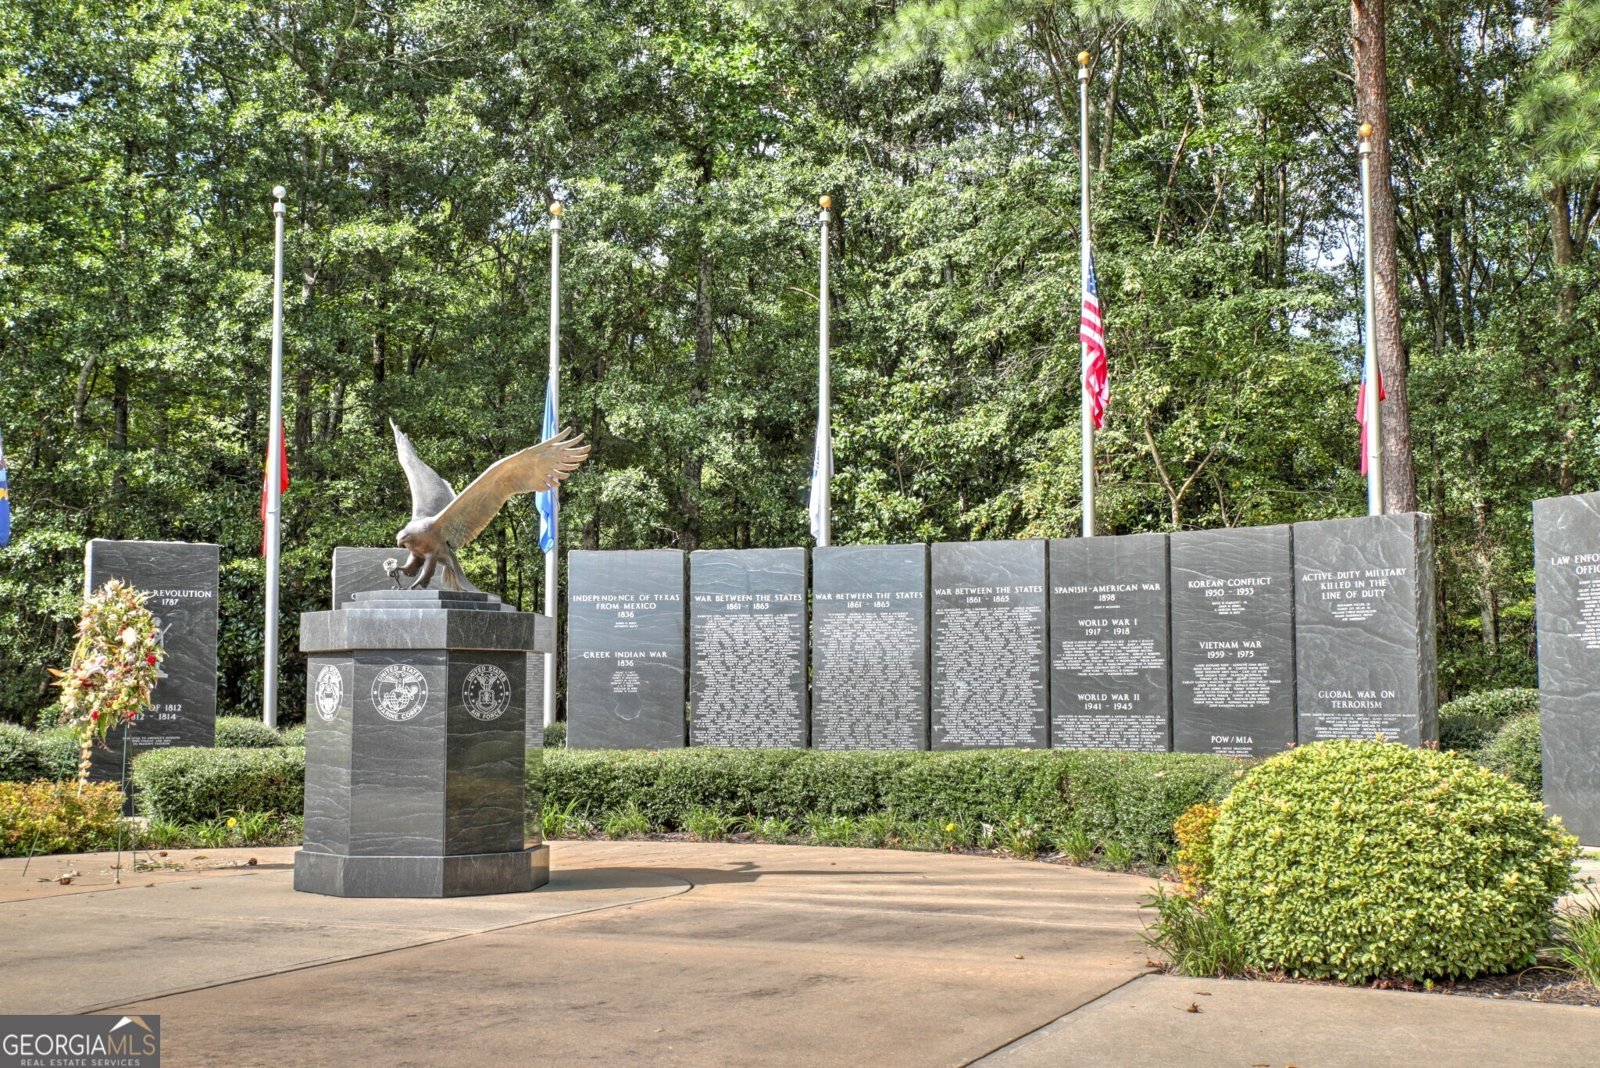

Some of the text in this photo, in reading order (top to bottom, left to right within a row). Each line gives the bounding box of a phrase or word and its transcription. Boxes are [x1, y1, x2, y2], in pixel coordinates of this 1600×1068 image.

[1551, 553, 1600, 565] LAW ENFO
[1302, 568, 1406, 582] ACTIVE DUTY MILITARY
[1188, 578, 1271, 588] KOREAN CONFLICT
[1321, 581, 1351, 590] KILLED
[1054, 584, 1138, 594] SPANISH-AMERICAN
[1322, 591, 1341, 600] LINE
[1362, 589, 1385, 598] DUTY
[377, 666, 422, 681] UNITED STATES
[1318, 691, 1353, 699] GLOBAL
[1331, 701, 1382, 709] TERRORISM
[377, 704, 422, 720] MARINE CORPS
